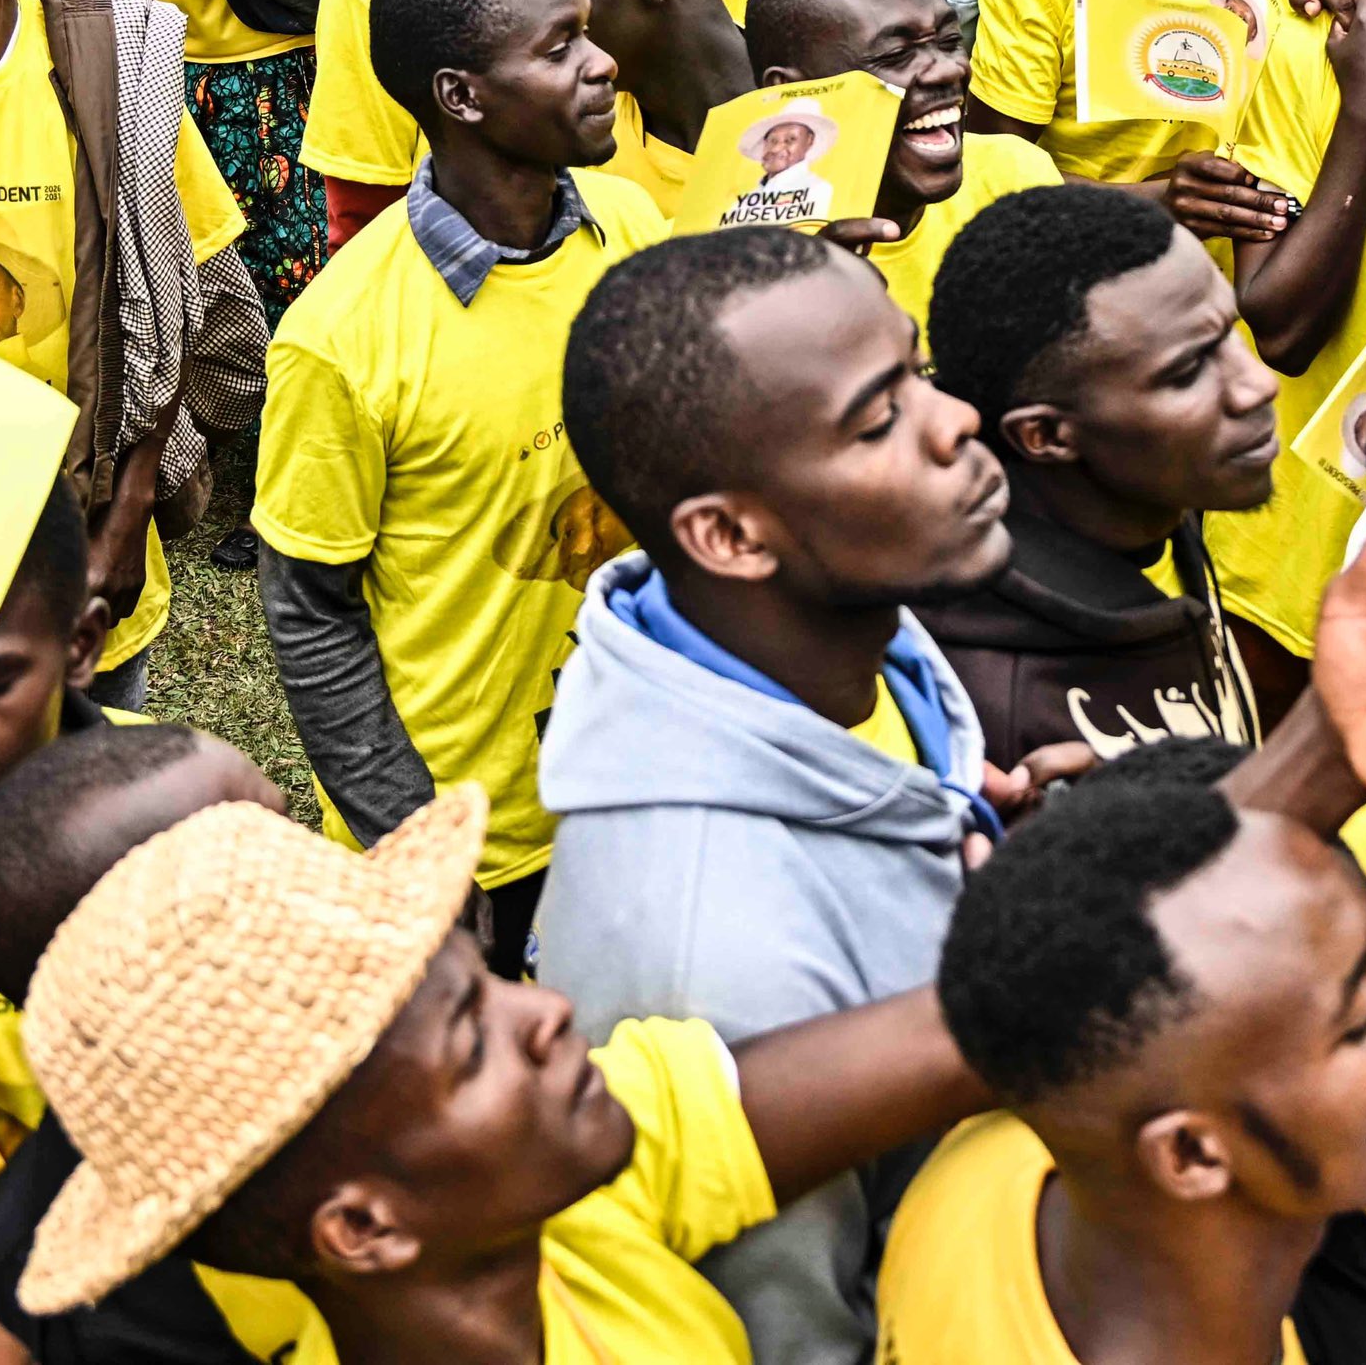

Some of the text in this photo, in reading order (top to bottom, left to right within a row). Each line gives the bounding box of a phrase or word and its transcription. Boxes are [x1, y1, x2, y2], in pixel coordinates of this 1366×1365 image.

[780, 83, 835, 99] PRESIDENT
[44, 185, 62, 193] 2026
[44, 193, 62, 201] 2031
[737, 187, 810, 209] YOWERI
[719, 201, 816, 227] MUSEVENI
